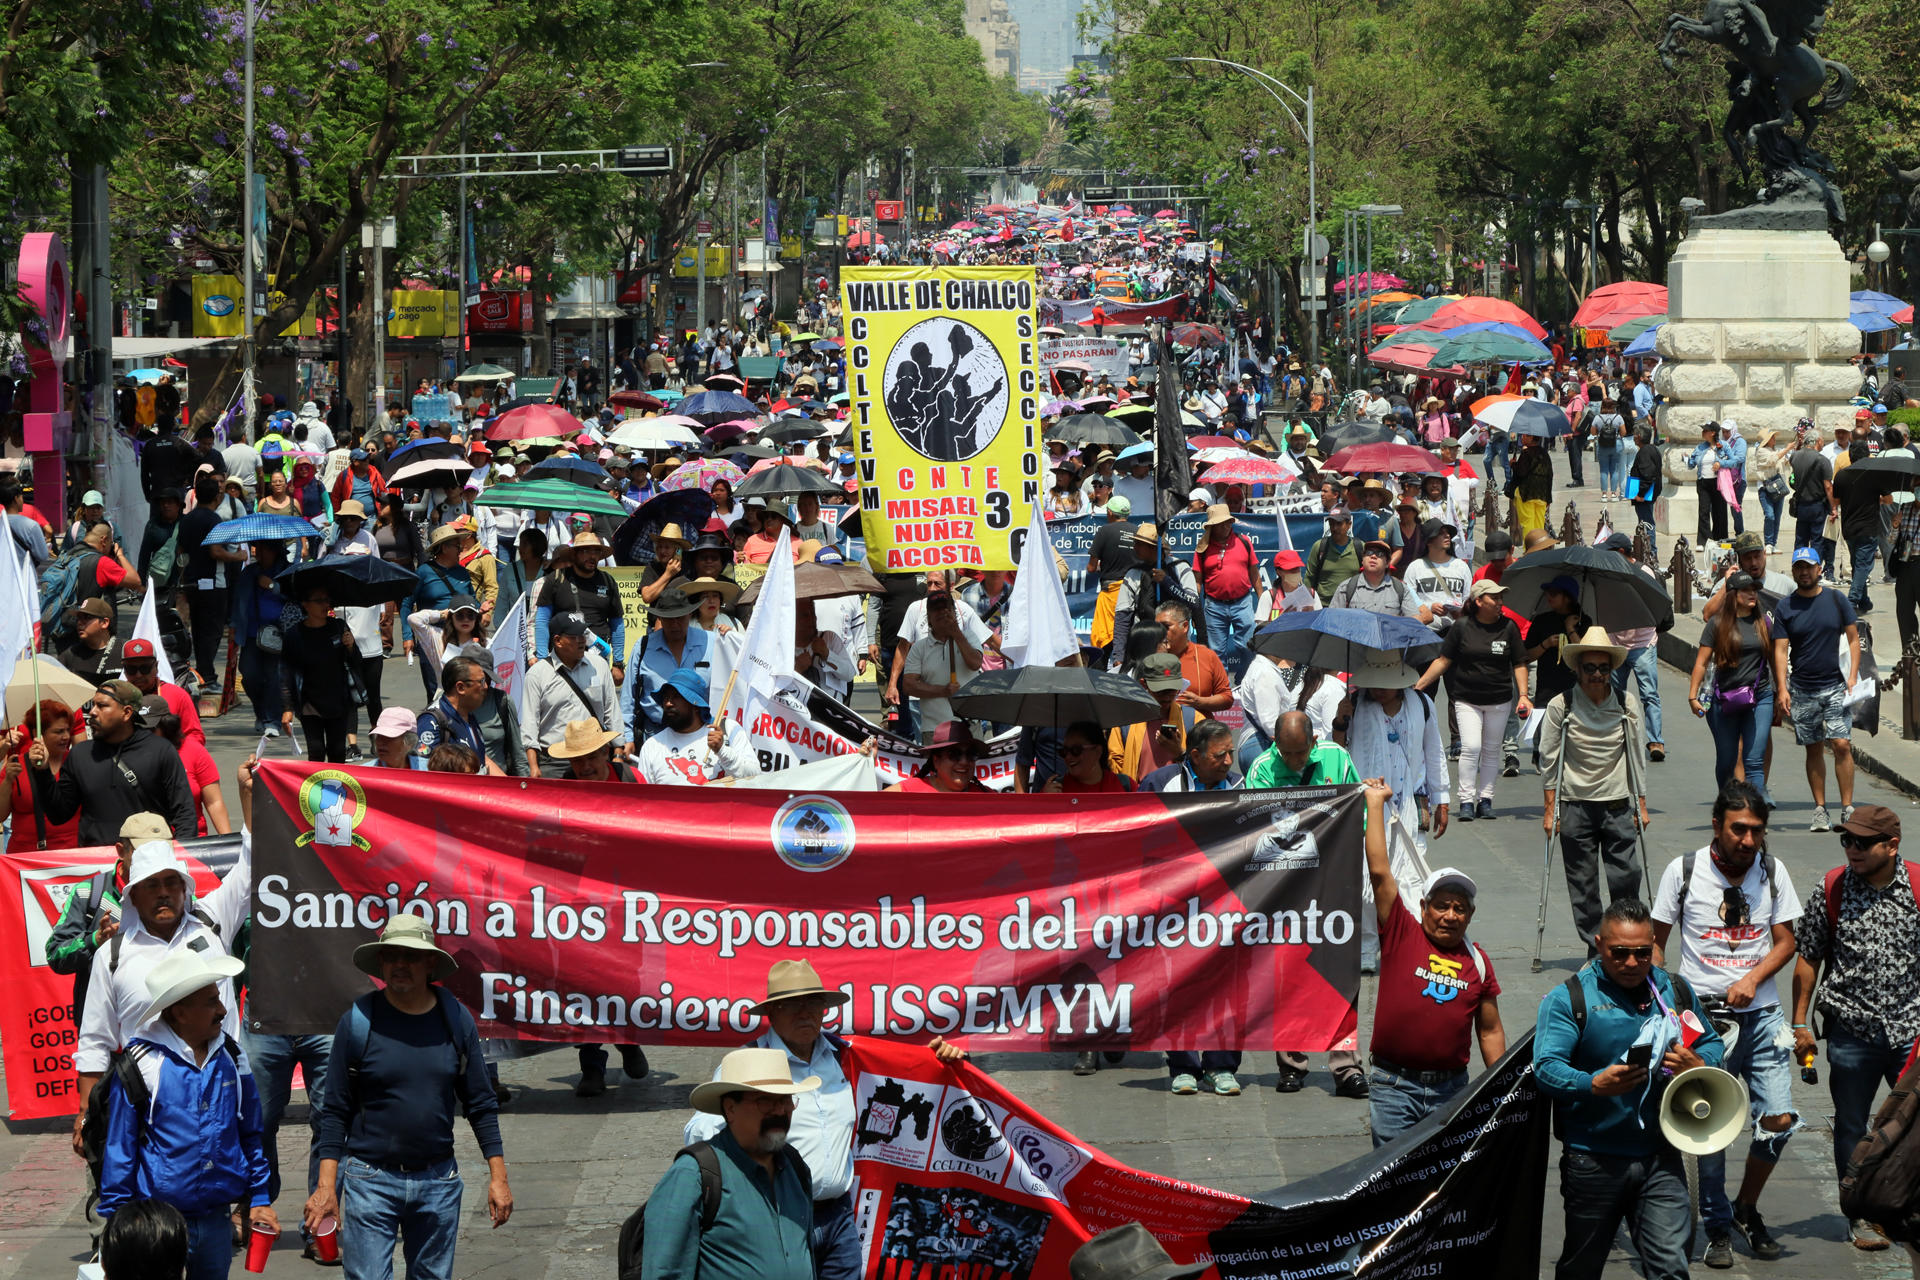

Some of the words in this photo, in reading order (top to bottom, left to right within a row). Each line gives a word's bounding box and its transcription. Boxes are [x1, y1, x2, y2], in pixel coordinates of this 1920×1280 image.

[846, 281, 911, 312] VALLE
[914, 279, 943, 310] DE
[945, 279, 1032, 311] CHALCO
[398, 305, 437, 313] mercado
[398, 313, 420, 322] pago
[1040, 351, 1060, 363] ¡NO
[851, 317, 881, 511] CCLTEVM
[898, 465, 999, 491] CNTE
[886, 496, 979, 520] MISAEL
[895, 518, 975, 543] NUÑEZ
[1055, 536, 1073, 549] de
[1180, 532, 1192, 546] la
[886, 544, 984, 569] ACOSTA
[793, 837, 837, 848] FRENTE
[255, 873, 470, 937] Sanción
[486, 899, 517, 939] a
[529, 885, 607, 944] los
[622, 890, 984, 959] Responsables
[998, 896, 1078, 951] del
[1093, 896, 1356, 960] quebranto
[1414, 966, 1470, 991] BURBERRY
[479, 971, 762, 1034] Financiero
[821, 982, 855, 1037] el
[870, 982, 1135, 1037] ISSEMYM
[33, 1053, 73, 1074] LOS
[932, 1159, 999, 1182] CCLTEVM
[1395, 1163, 1438, 1187] integra
[1440, 1157, 1458, 1171] las
[1093, 1177, 1110, 1189] de
[1111, 1183, 1147, 1199] Lucha
[1103, 1166, 1116, 1178] El
[1117, 1169, 1172, 1191] Colectivo
[1173, 1179, 1188, 1192] de
[1190, 1182, 1241, 1201] Docentes
[1092, 1189, 1166, 1217] Pensionistas
[1193, 1246, 1269, 1266] ¡Abrogación
[1271, 1243, 1289, 1259] de
[1291, 1241, 1304, 1257] la
[1305, 1241, 1331, 1256] Ley
[1333, 1231, 1355, 1249] del
[1357, 1209, 1424, 1242] ISSEMYM
[1425, 1238, 1454, 1256] para
[1280, 1259, 1351, 1280] financiero
